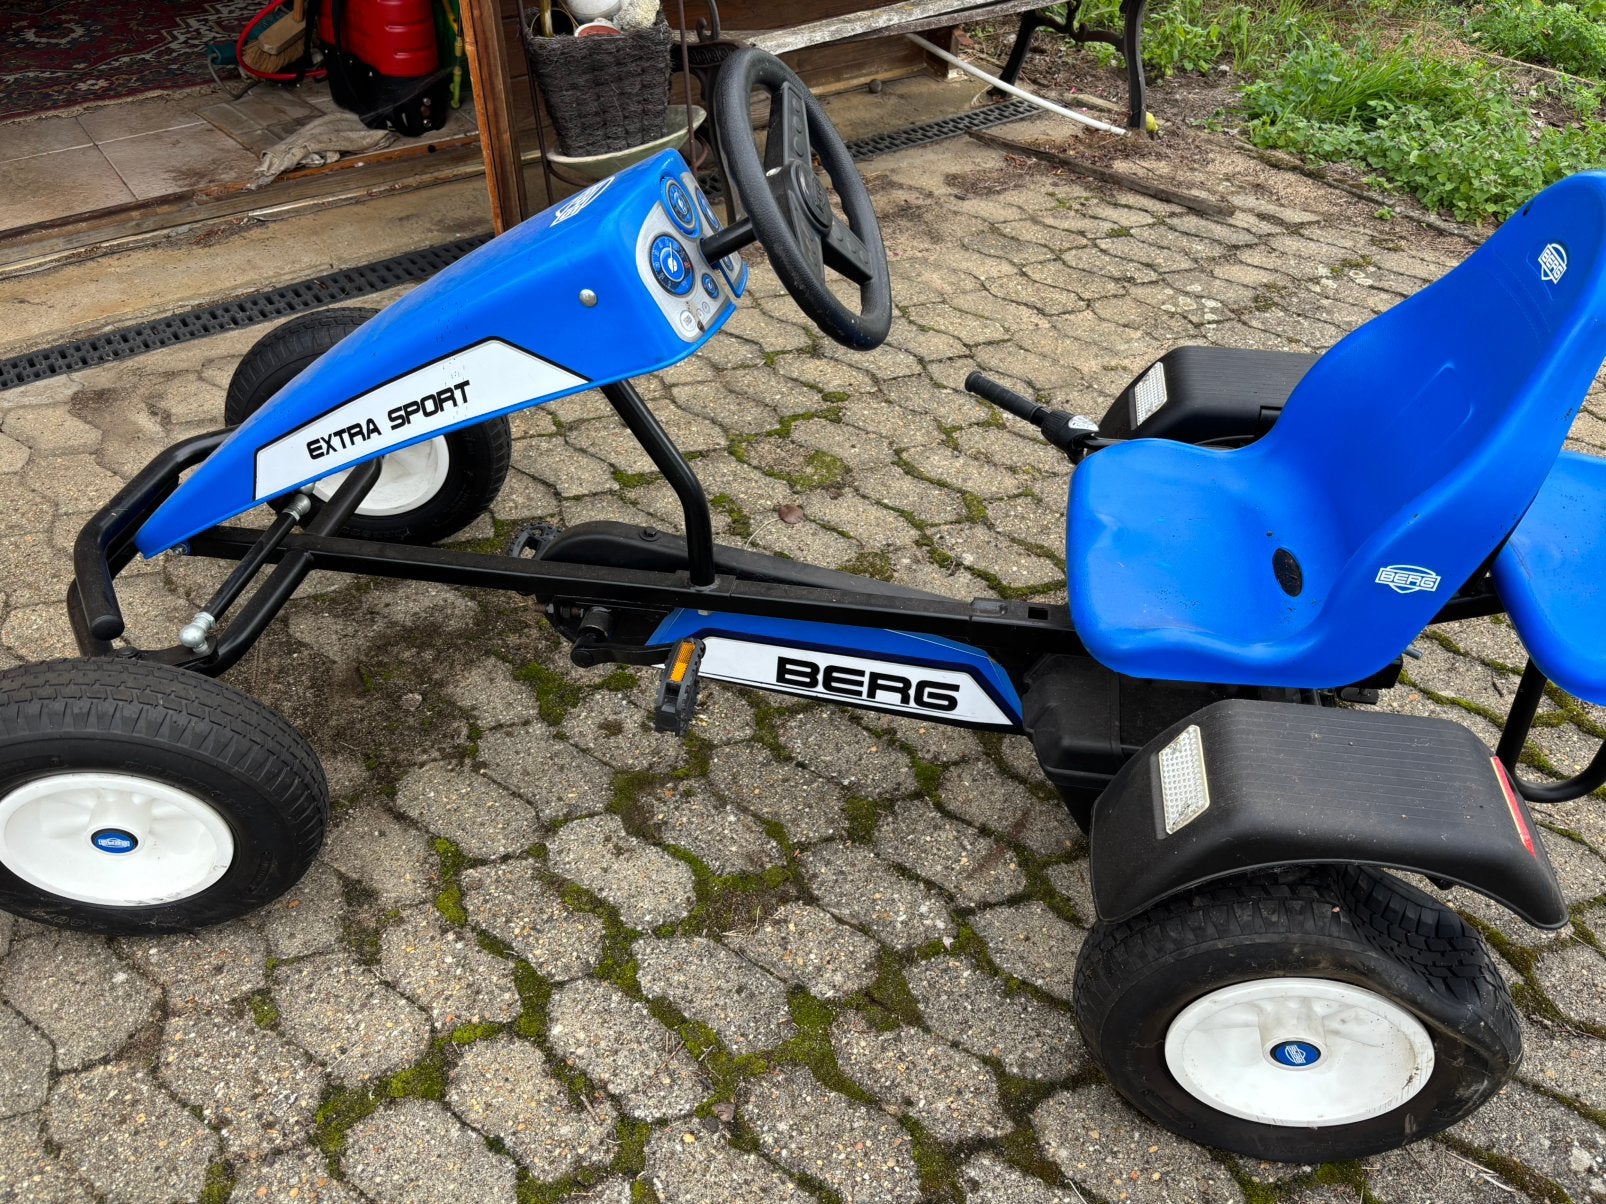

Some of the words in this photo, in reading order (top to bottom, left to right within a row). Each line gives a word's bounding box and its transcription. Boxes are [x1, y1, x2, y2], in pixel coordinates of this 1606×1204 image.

[1541, 247, 1565, 279] BERG
[306, 418, 382, 460] EXTRA
[387, 380, 471, 431] SPORT
[1380, 570, 1436, 588] BERG
[775, 656, 961, 712] BERG
